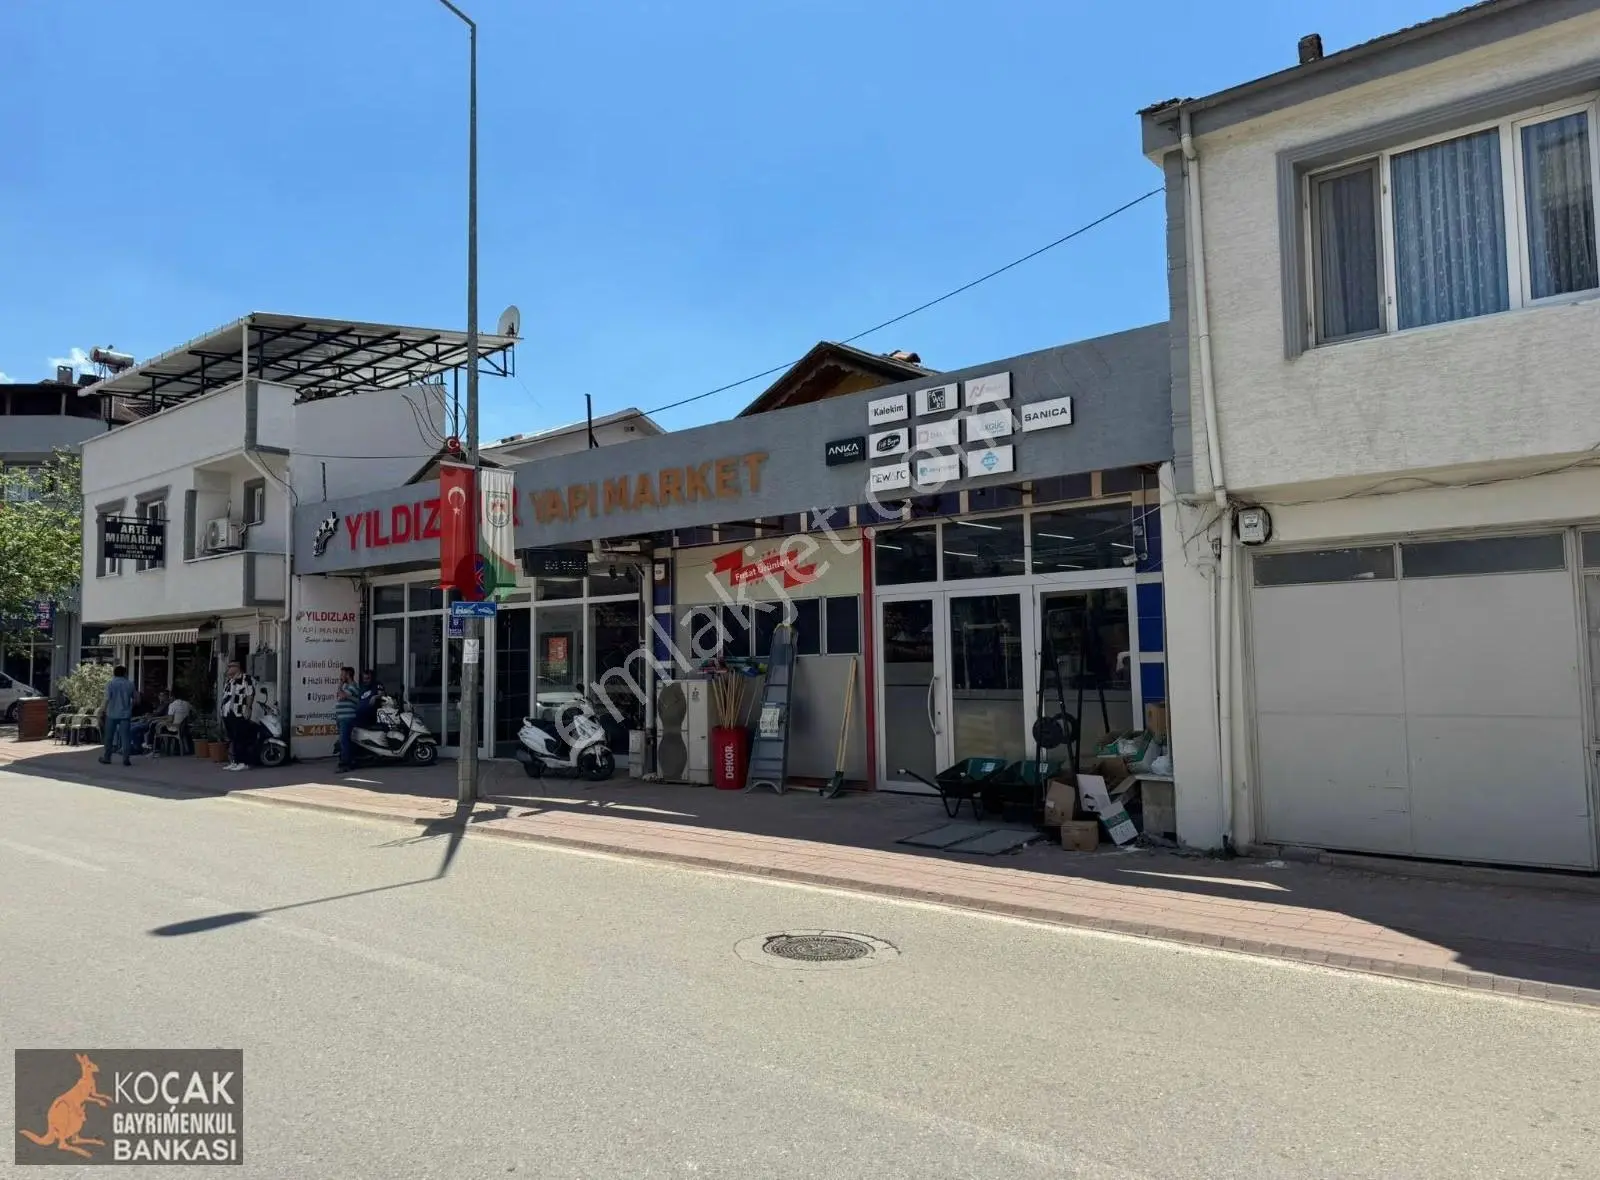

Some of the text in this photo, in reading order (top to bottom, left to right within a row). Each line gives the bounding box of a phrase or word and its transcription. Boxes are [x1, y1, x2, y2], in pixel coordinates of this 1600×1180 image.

[873, 404, 904, 417] Kalekim
[1024, 407, 1068, 422] SANICA
[828, 443, 859, 456] ANKA
[529, 483, 598, 524] YAPI
[603, 452, 770, 516] MARKET
[120, 524, 149, 535] ARTE
[306, 611, 356, 622] YILDIZLAR
